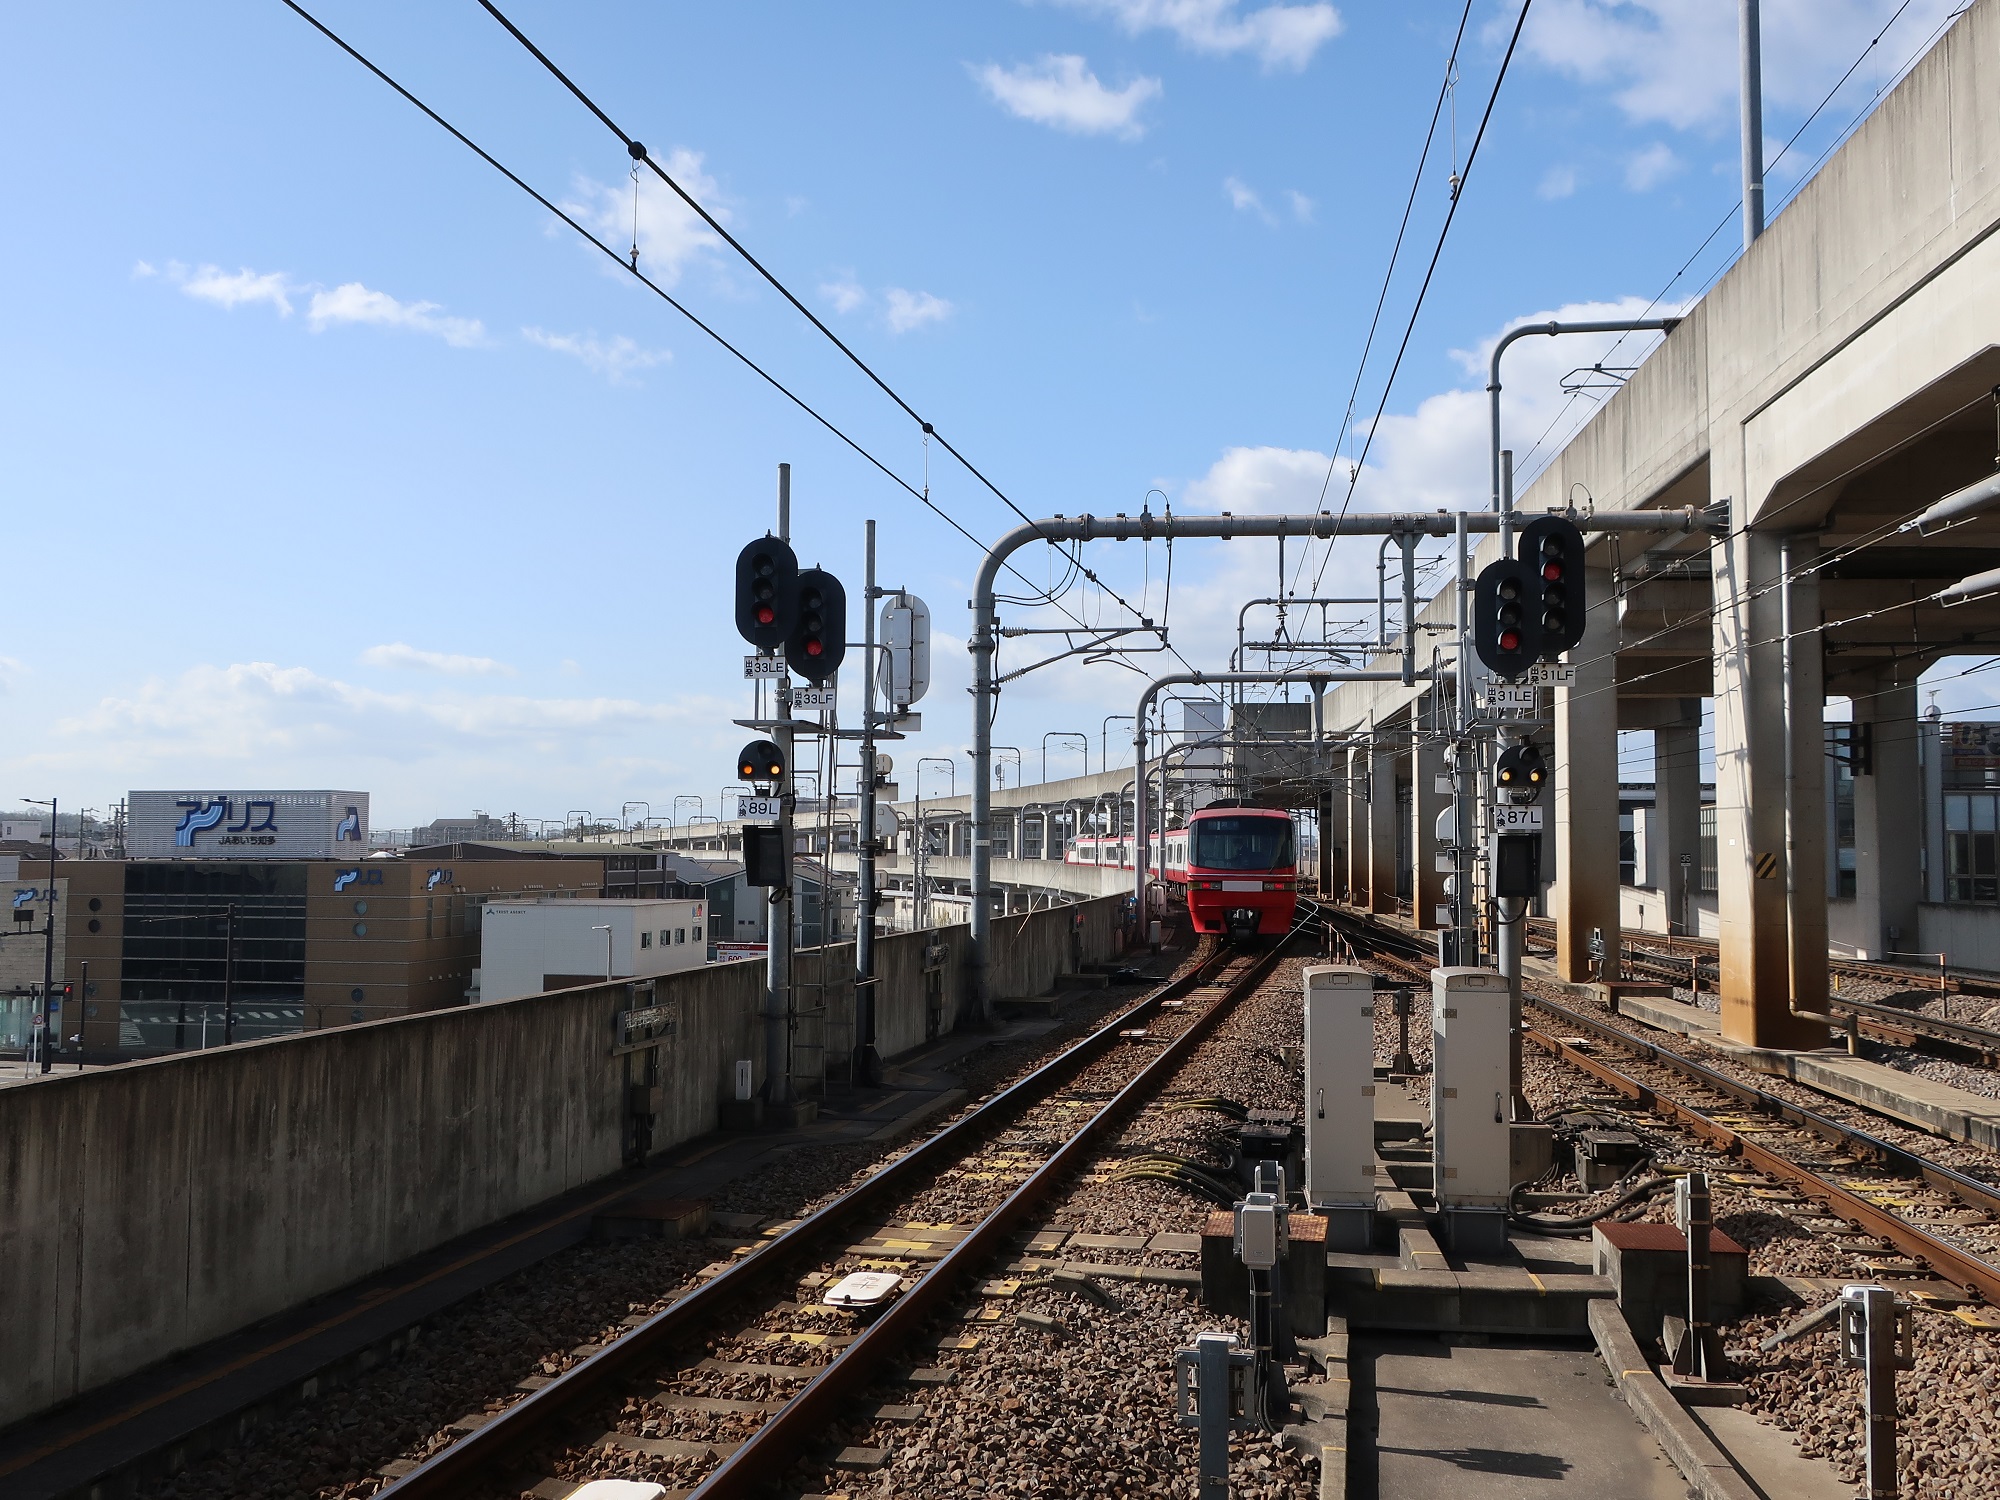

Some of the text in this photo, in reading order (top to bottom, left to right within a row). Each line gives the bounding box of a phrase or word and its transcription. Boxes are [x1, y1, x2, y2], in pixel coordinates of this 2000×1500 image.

[746, 660, 784, 677] 出発 33LE
[1530, 667, 1574, 685] 出発 31LF
[794, 691, 834, 708] 出発 33LF
[1487, 687, 1532, 706] 出発 31LE
[748, 802, 778, 815] 89L
[175, 795, 279, 848] アグリス
[1507, 811, 1541, 824] 87L
[218, 835, 277, 846] JAあいち知多
[1680, 854, 1691, 863] 35
[334, 866, 384, 892] アグリス
[426, 866, 454, 892] アグリス
[12, 887, 59, 909] アグリス
